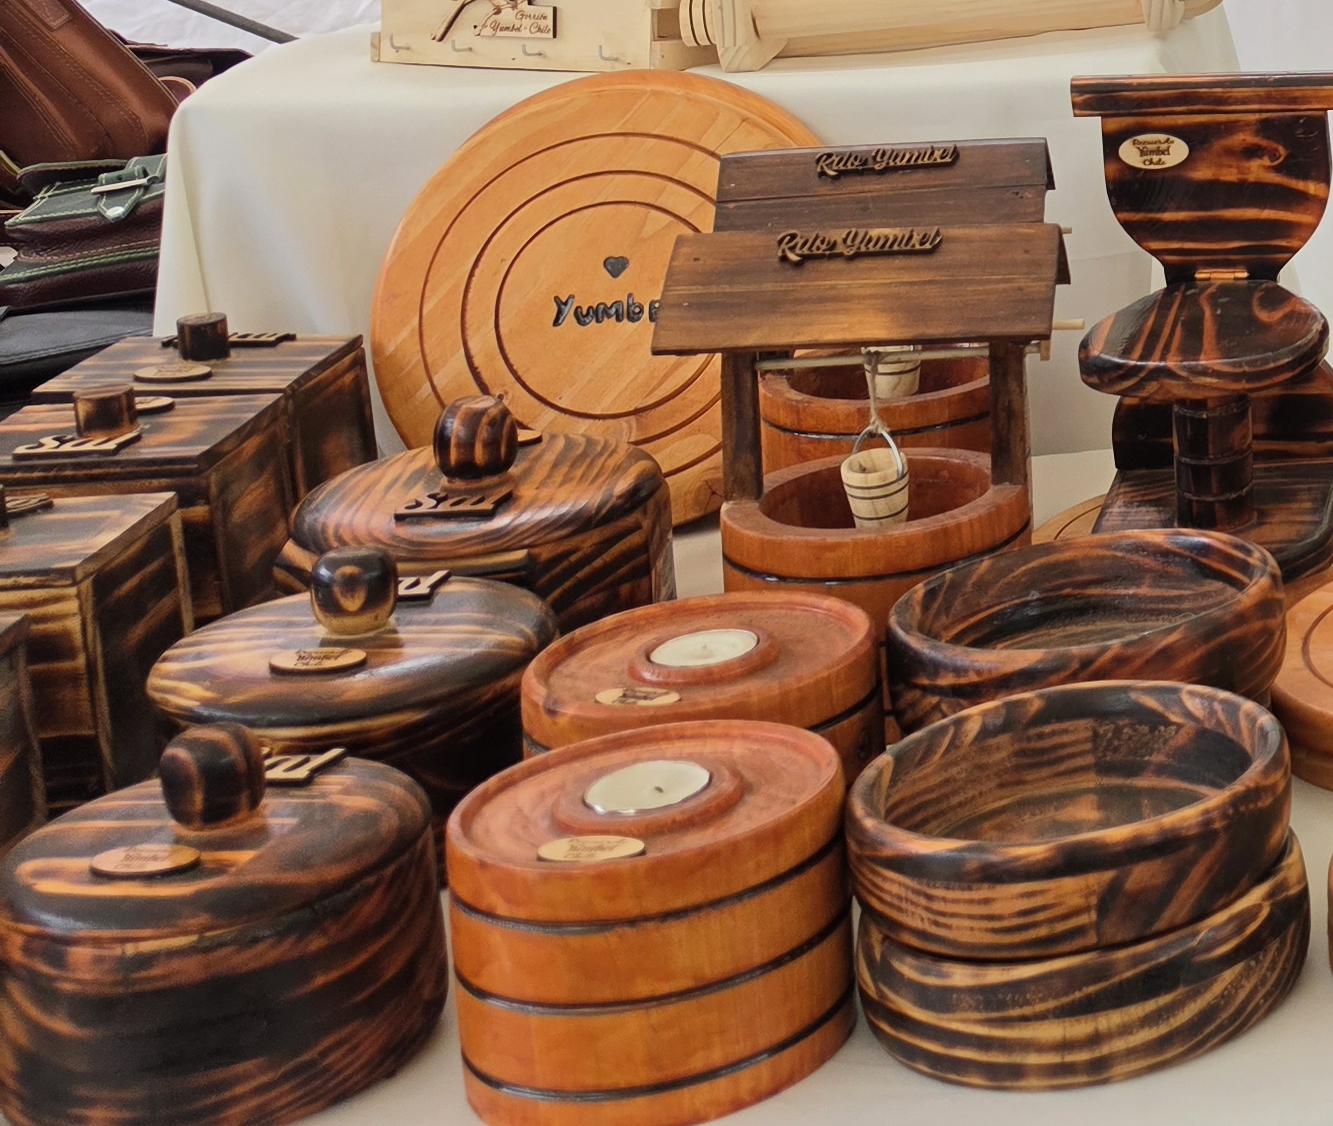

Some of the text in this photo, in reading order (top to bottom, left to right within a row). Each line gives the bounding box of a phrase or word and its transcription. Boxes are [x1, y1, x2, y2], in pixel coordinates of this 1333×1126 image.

[529, 22, 551, 34] Chile
[871, 144, 960, 173] Yumbel
[1143, 158, 1166, 166] Chile
[841, 226, 943, 261] Yumbel
